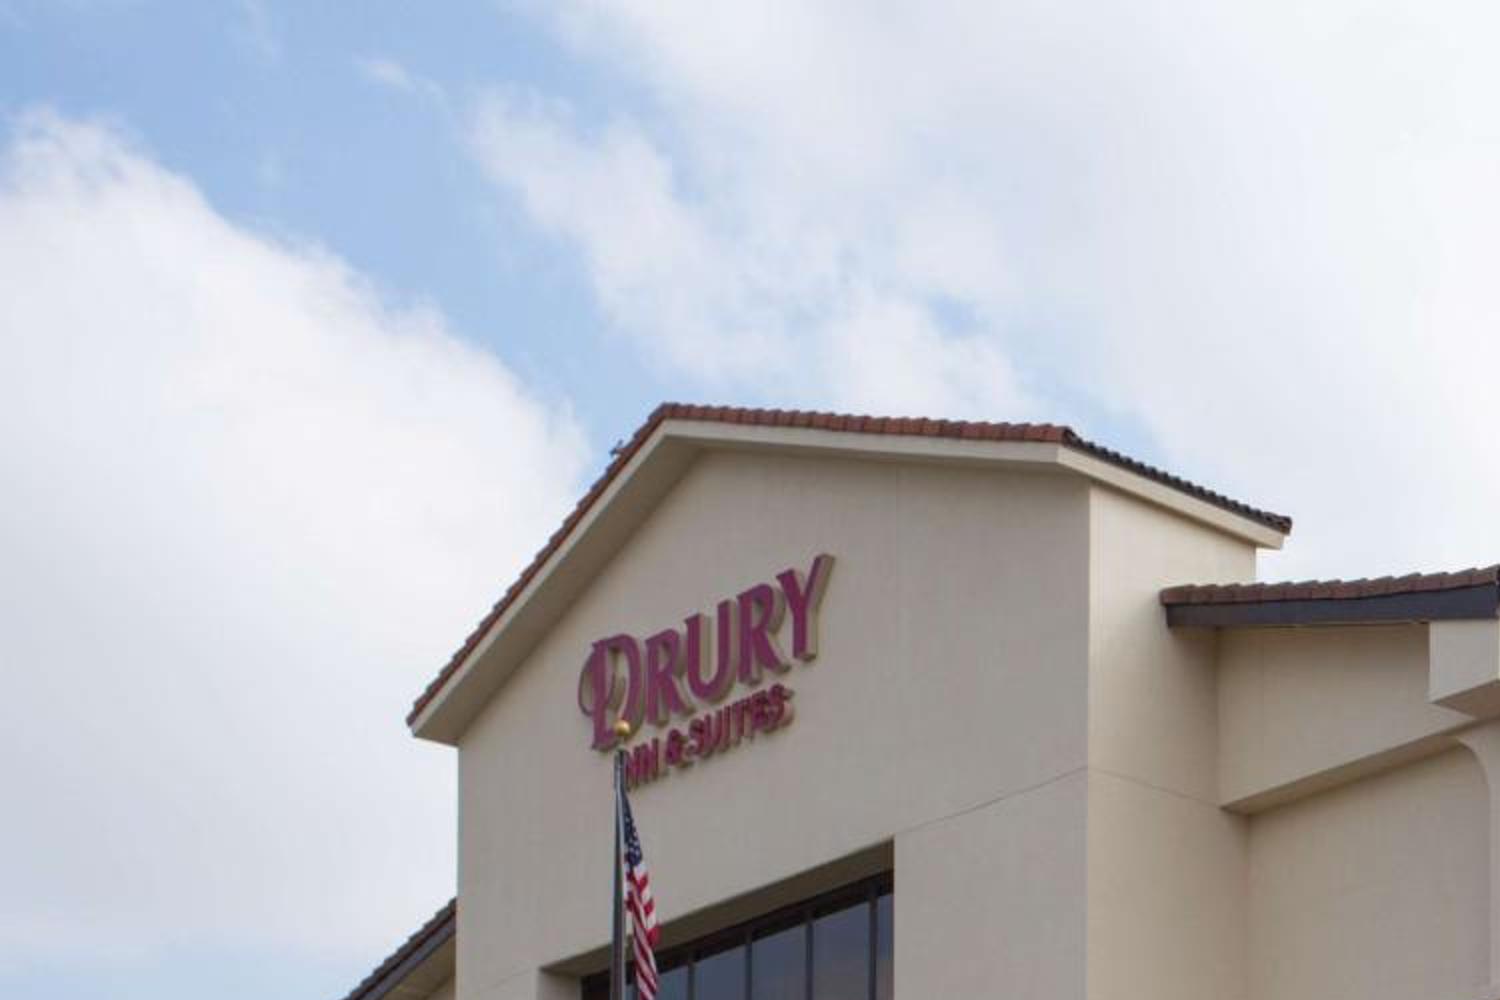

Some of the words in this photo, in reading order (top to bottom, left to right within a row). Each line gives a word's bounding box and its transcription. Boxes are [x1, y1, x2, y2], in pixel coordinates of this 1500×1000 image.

[577, 553, 834, 753] DRURY
[624, 737, 661, 791] NN
[665, 728, 693, 769] &
[689, 683, 795, 760] SUITES
